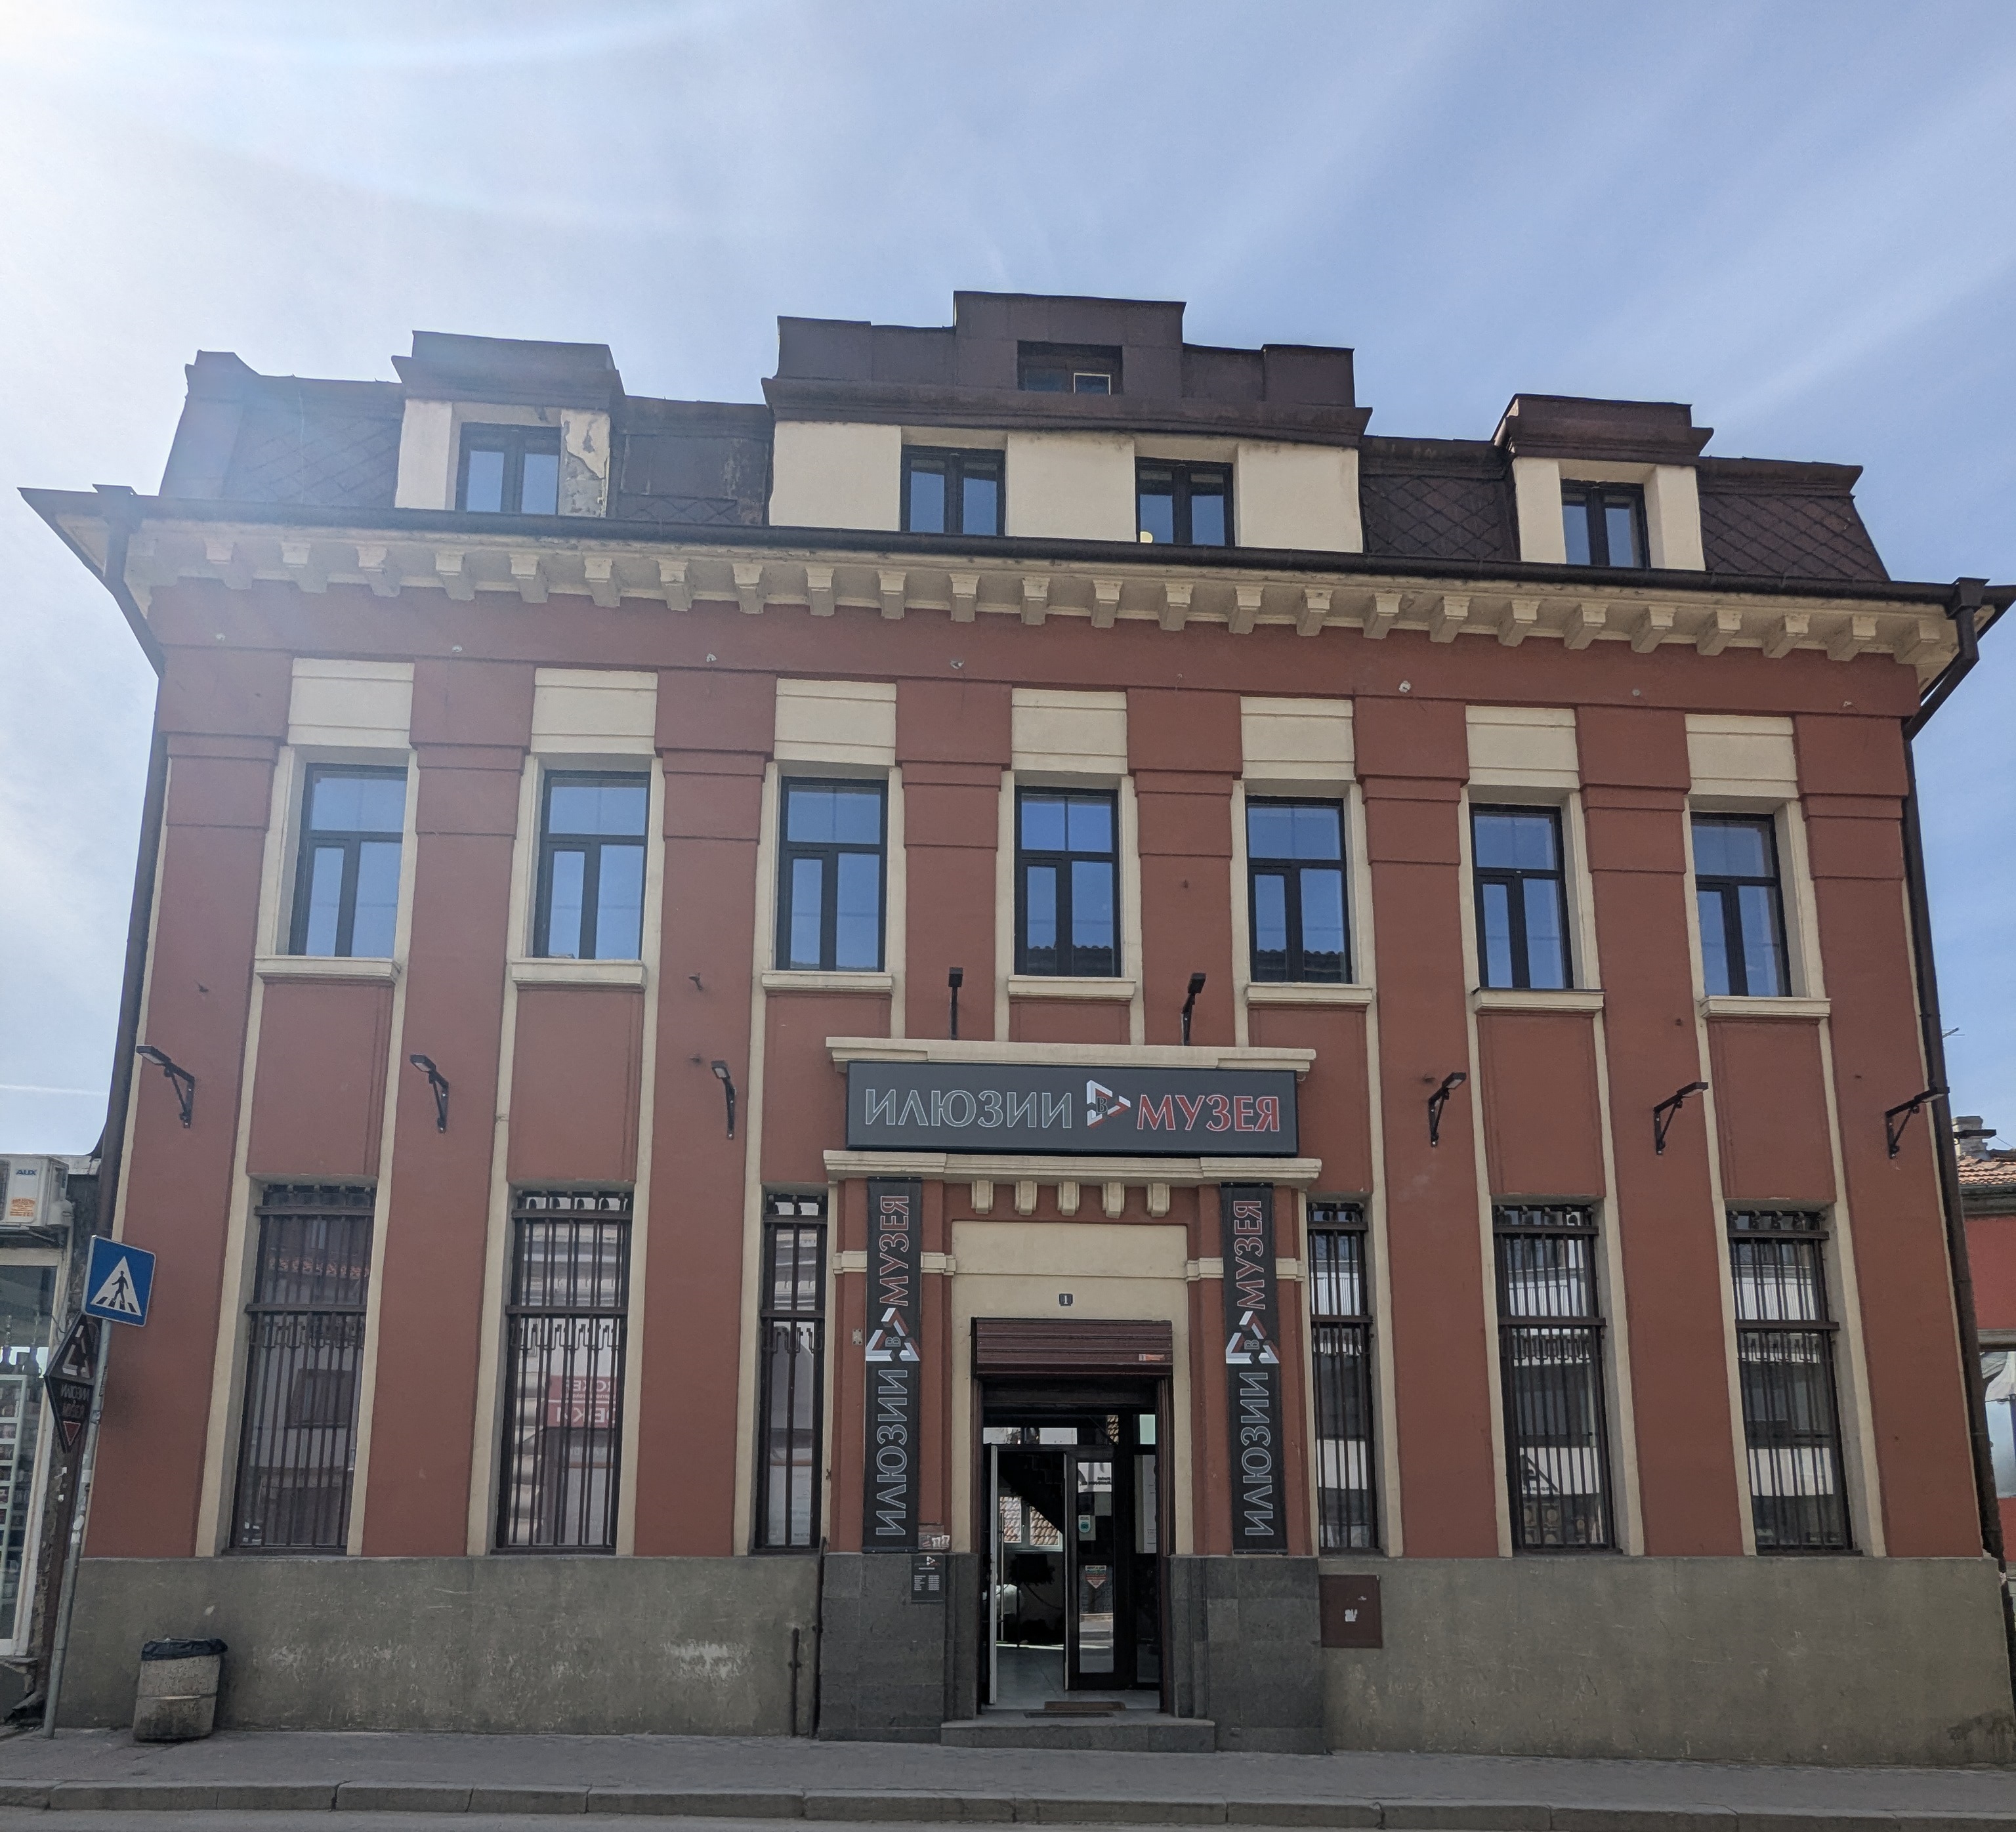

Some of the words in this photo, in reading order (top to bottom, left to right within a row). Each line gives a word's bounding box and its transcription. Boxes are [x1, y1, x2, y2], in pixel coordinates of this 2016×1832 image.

[864, 1087, 1072, 1129] ИЛЮЗИИ
[1137, 1094, 1280, 1133] МУЗЕЯ
[879, 1196, 910, 1306] МУЗЕЯ
[1063, 1295, 1069, 1304] 1
[1233, 1200, 1266, 1310] МУЗЕЯ
[875, 1369, 908, 1535] ИЛЮЗИИ
[1239, 1372, 1274, 1535] ИЛЮЗИИ
